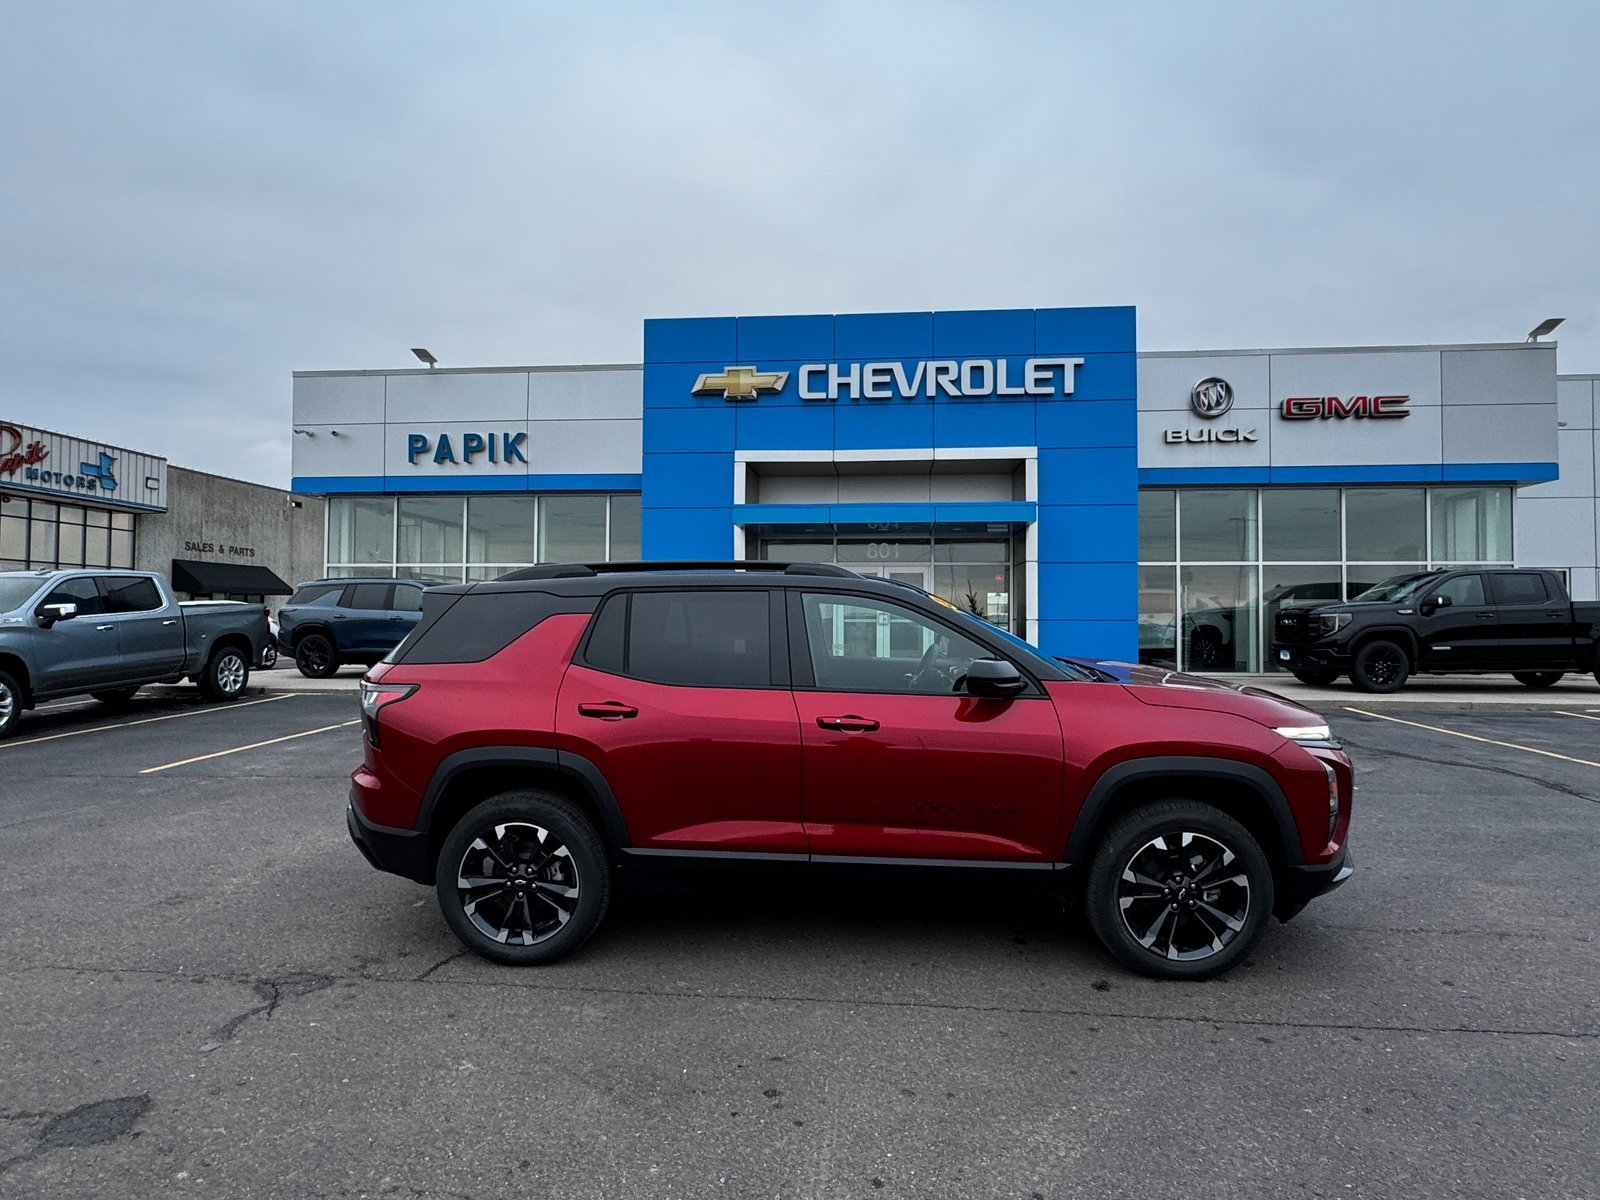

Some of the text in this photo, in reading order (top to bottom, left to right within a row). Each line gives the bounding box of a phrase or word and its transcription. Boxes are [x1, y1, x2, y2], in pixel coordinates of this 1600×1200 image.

[798, 357, 1085, 401] CHEVROLET
[1281, 395, 1411, 420] GMC
[1164, 427, 1258, 444] BUICK
[407, 432, 528, 465] PAPIK
[25, 466, 97, 491] MOTORS
[184, 541, 255, 558] SALES & PARTS
[866, 542, 899, 559] 801
